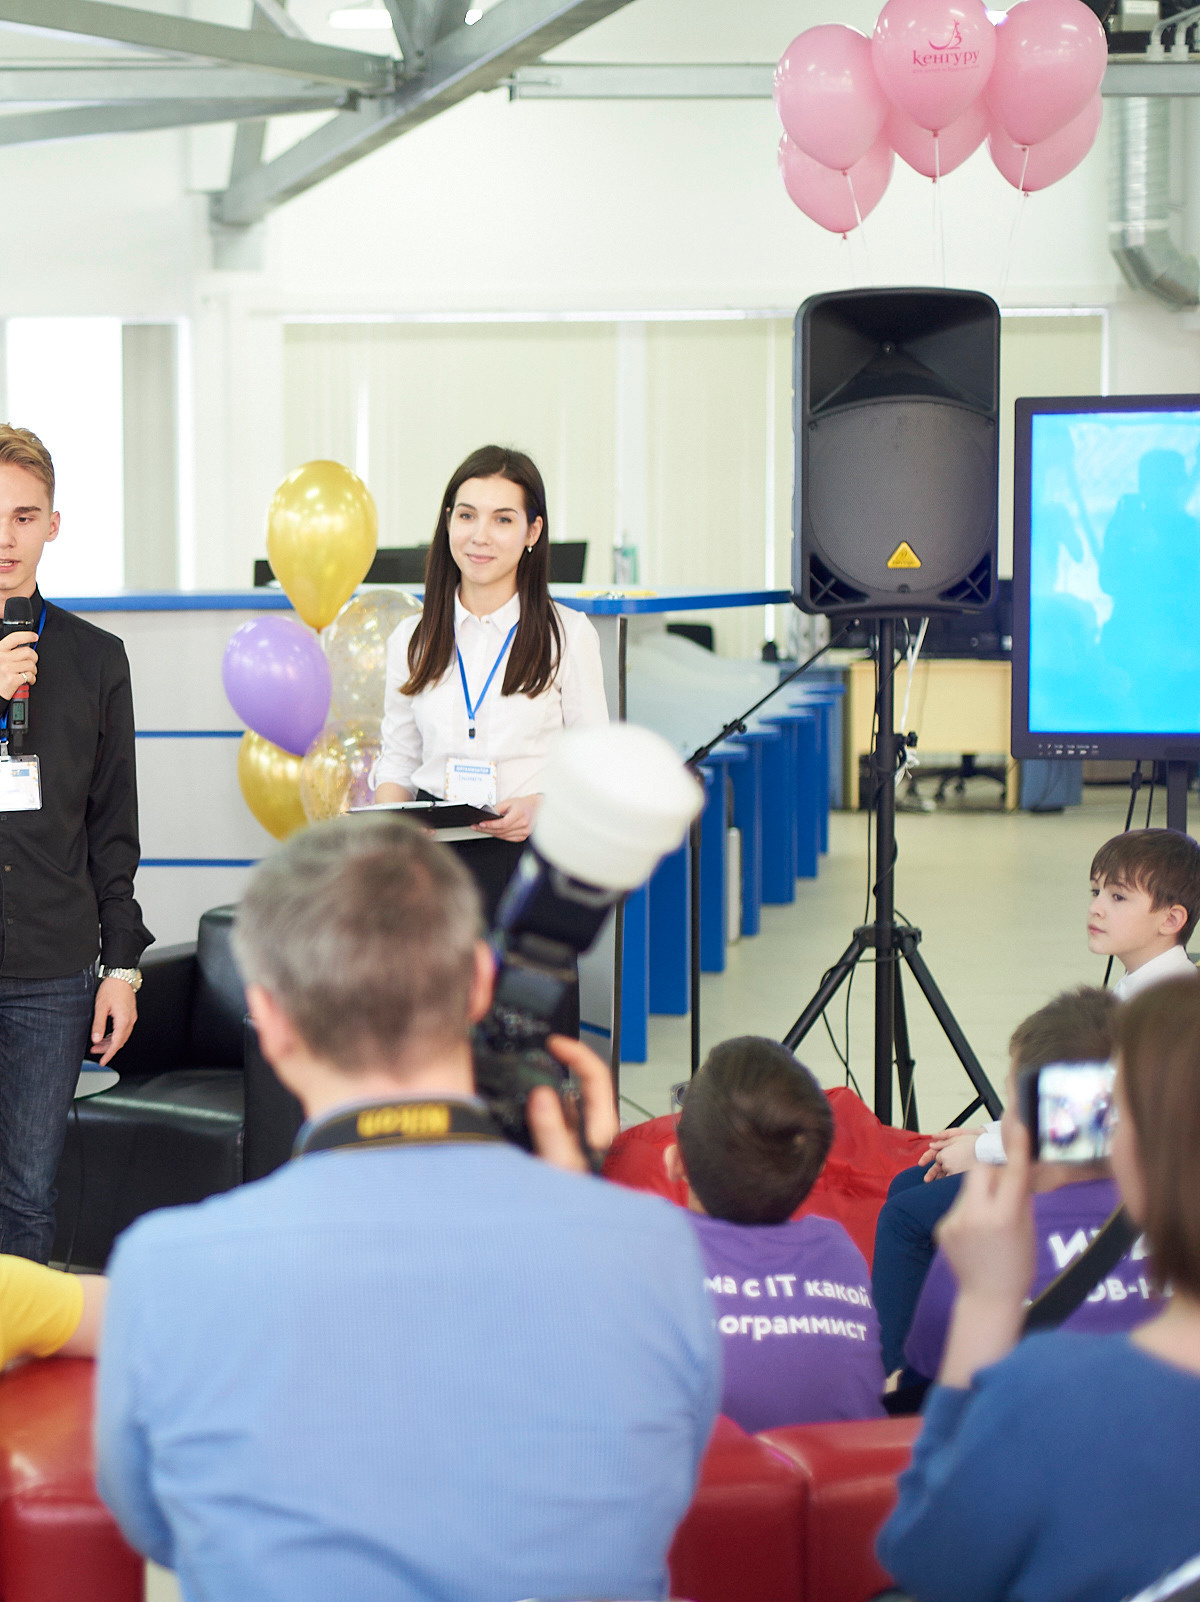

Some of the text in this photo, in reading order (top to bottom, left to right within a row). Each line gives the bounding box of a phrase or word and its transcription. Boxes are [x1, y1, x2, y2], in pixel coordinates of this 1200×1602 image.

[742, 1278, 761, 1298] с
[765, 1273, 797, 1298] IT
[803, 1278, 872, 1309] какой
[714, 1314, 867, 1341] ограммист
